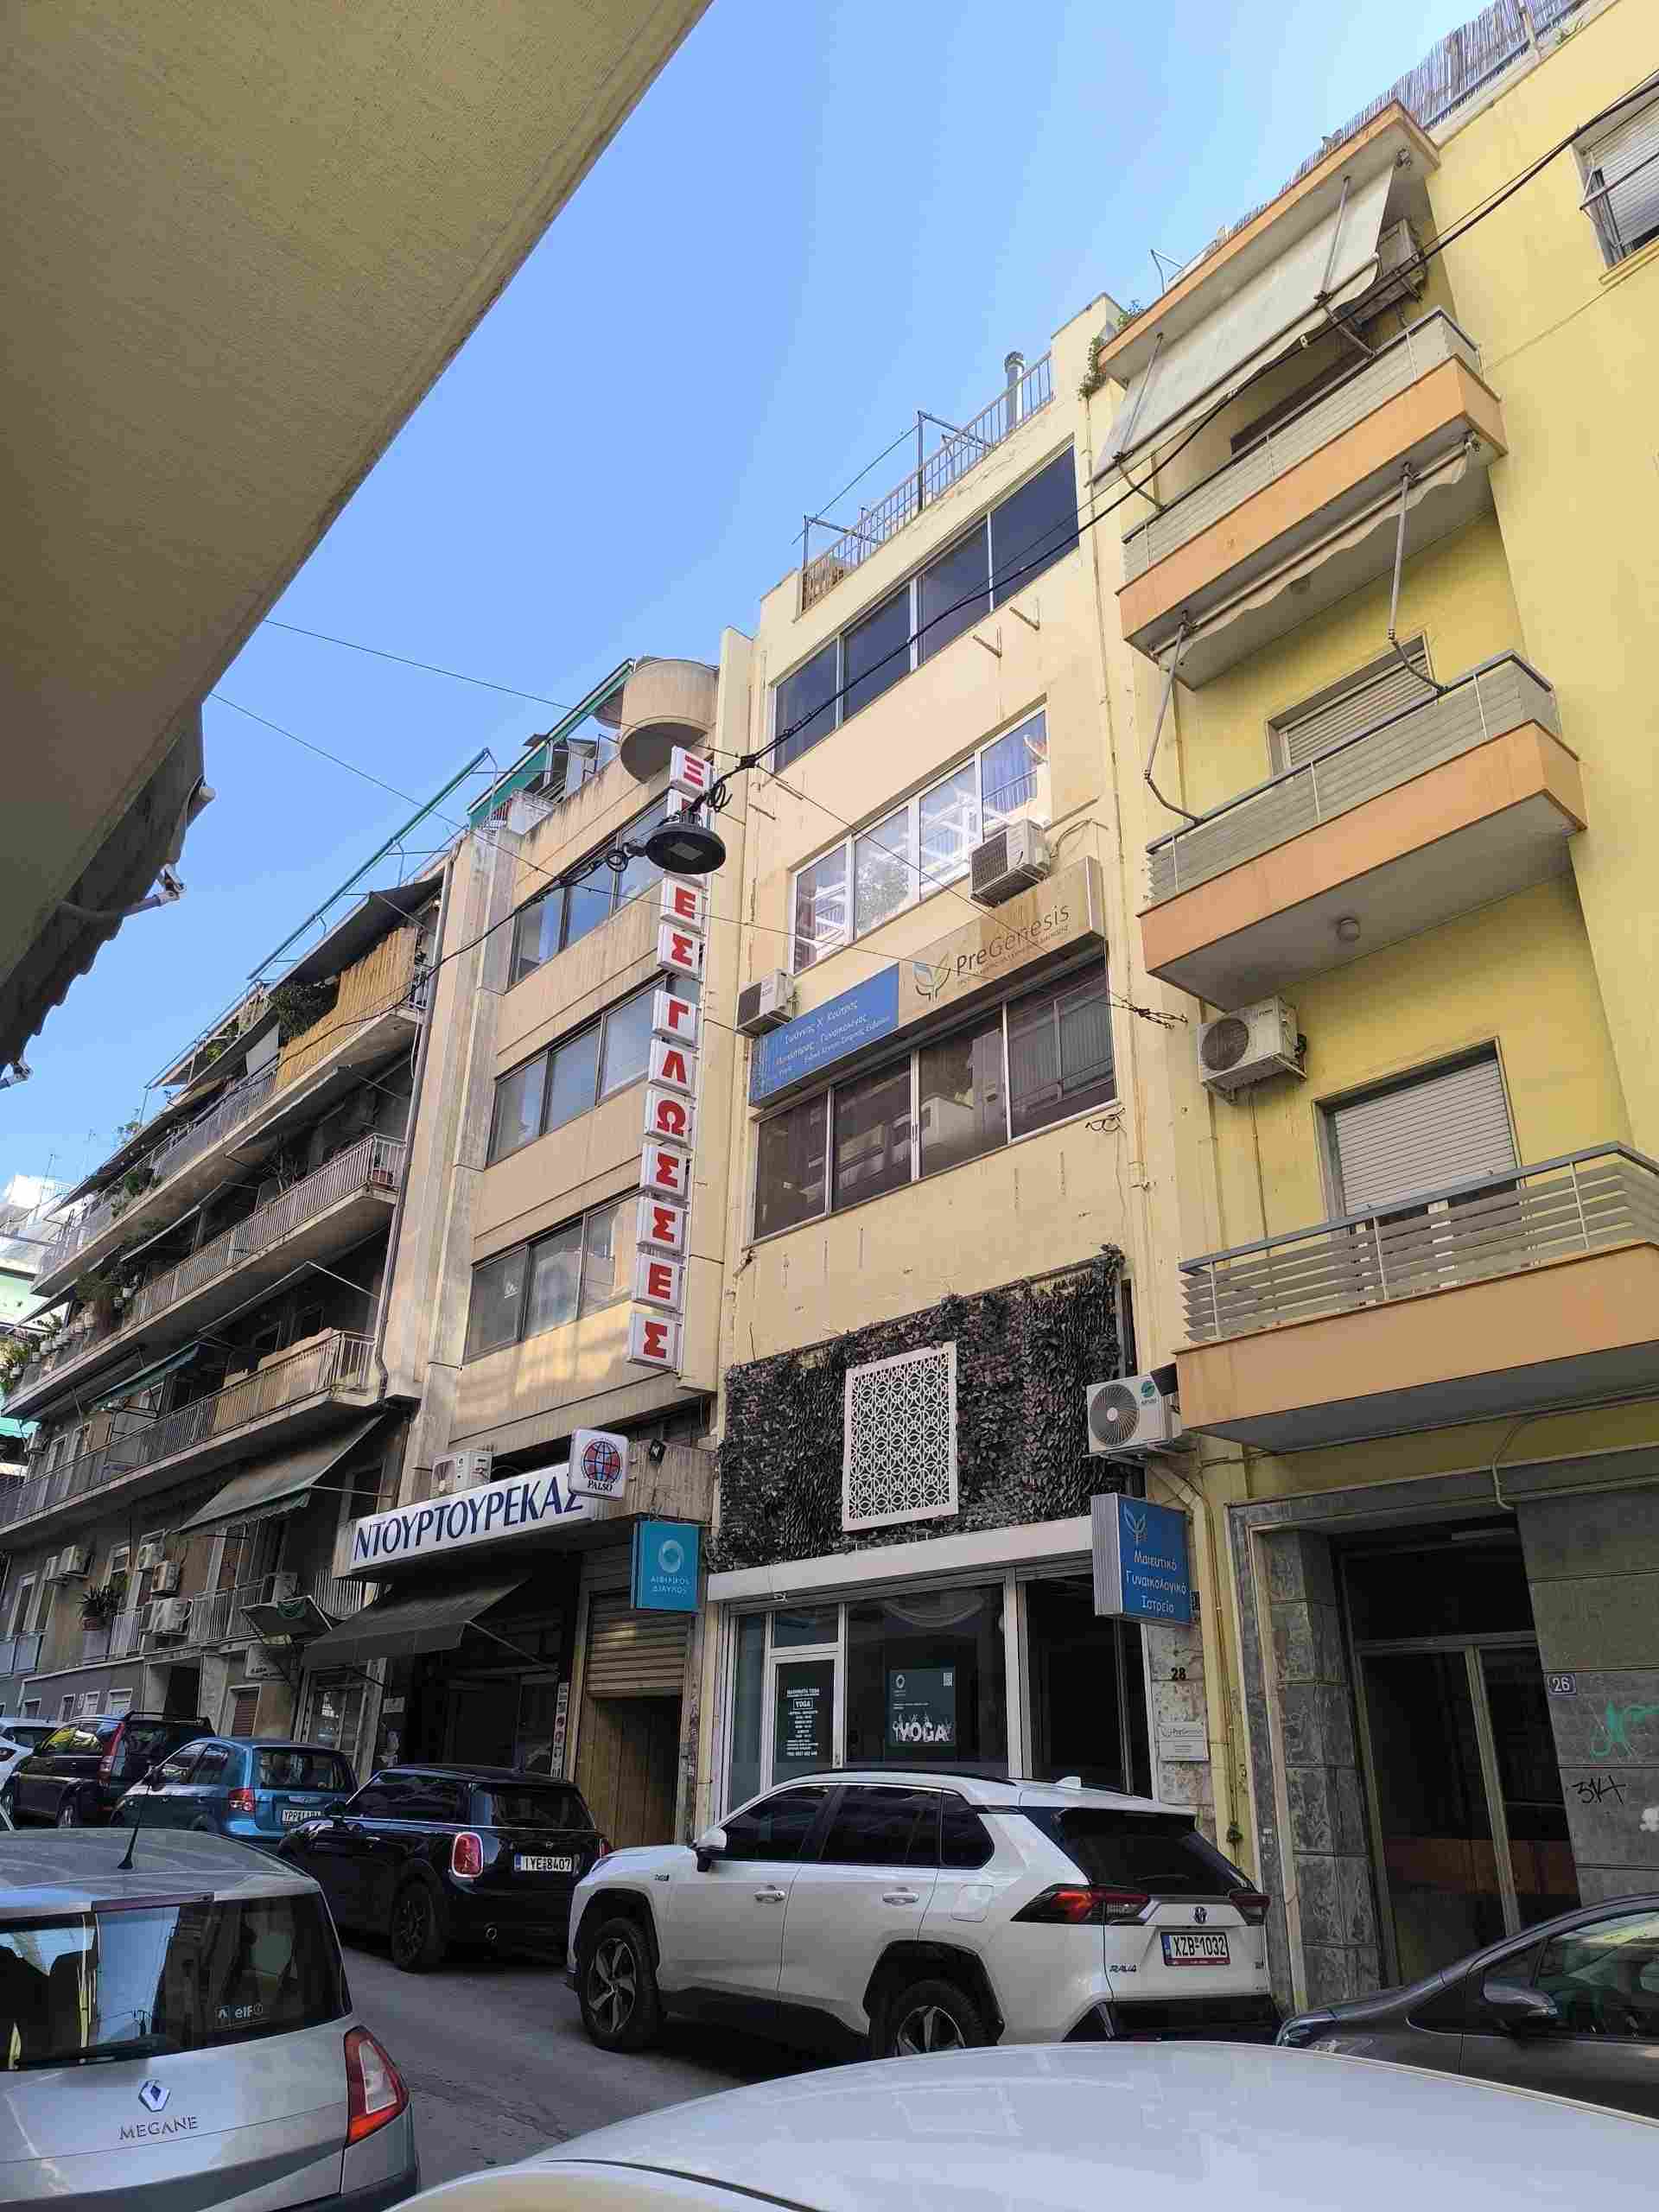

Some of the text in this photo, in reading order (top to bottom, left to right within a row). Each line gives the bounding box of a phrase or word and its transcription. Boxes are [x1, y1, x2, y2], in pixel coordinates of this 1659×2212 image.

[671, 753, 705, 967] ΞΕΣ
[957, 905, 1071, 976] PreGenesis
[643, 1000, 690, 1358] ΓΛΩΣΣΕΣ
[1171, 1667, 1186, 1681] 28
[1552, 1677, 1570, 1692] 26
[119, 2115, 199, 2141] MEGANE
